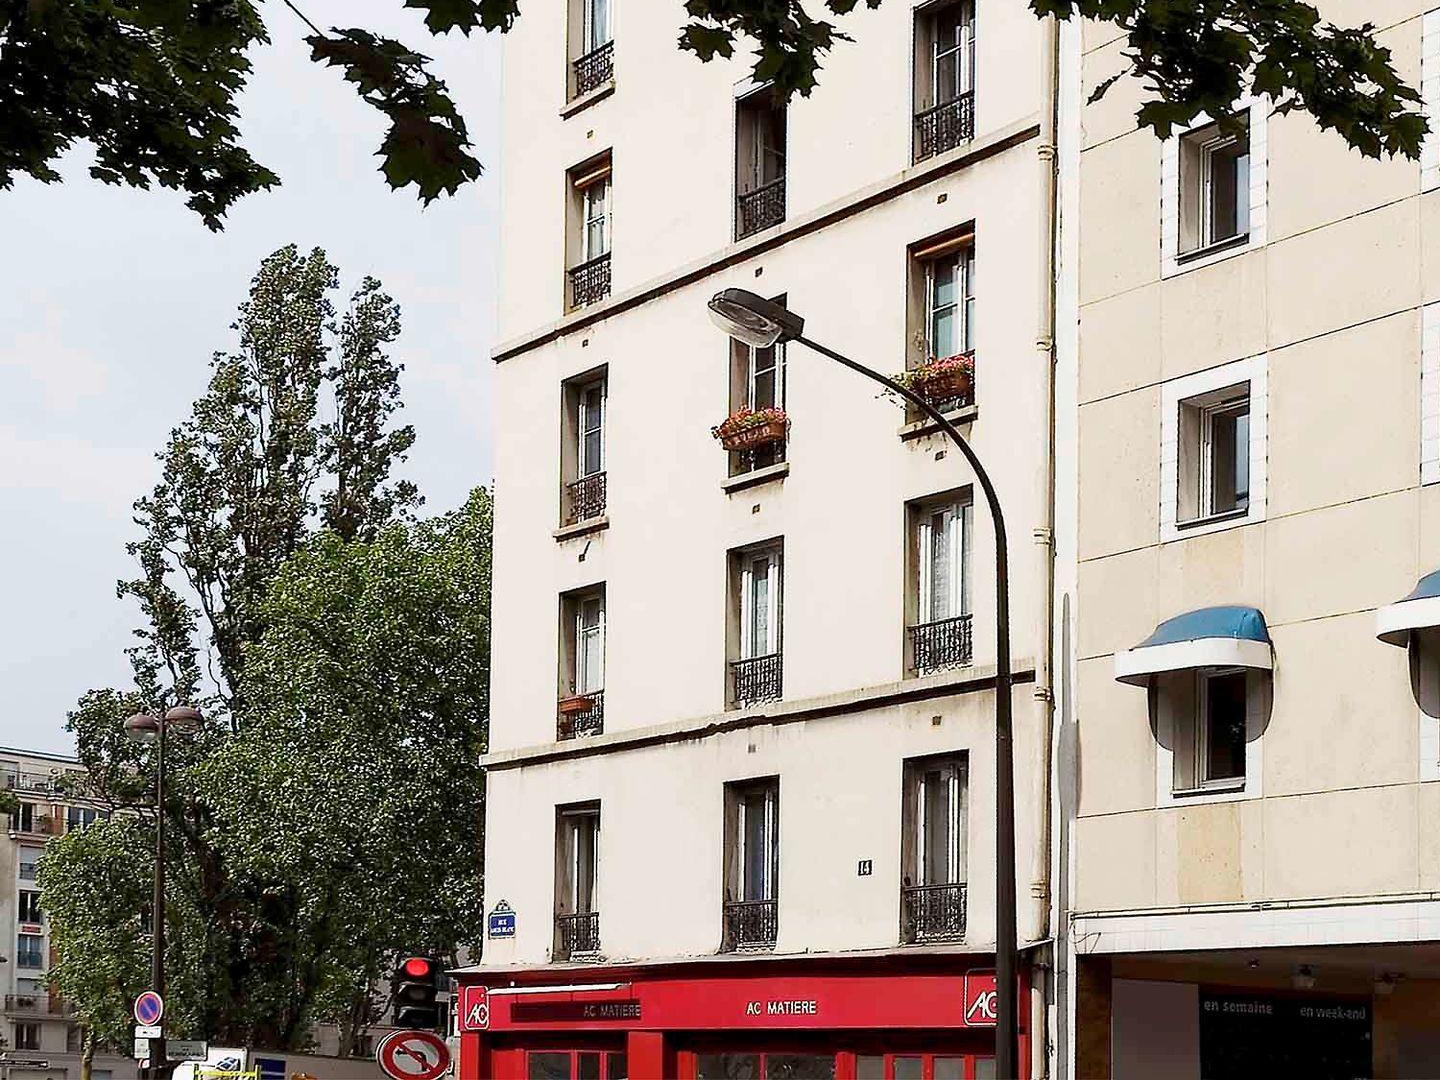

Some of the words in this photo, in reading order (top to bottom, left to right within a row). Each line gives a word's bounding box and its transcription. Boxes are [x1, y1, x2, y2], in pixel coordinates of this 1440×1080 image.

[583, 1004, 597, 1017] AC
[600, 1003, 641, 1017] MATIERE
[746, 1001, 761, 1015] AC
[767, 1000, 817, 1015] MATIERE
[1203, 1000, 1219, 1012] en
[1222, 1001, 1273, 1015] semaine
[1300, 1006, 1314, 1017] en
[1316, 1006, 1366, 1020] week-end
